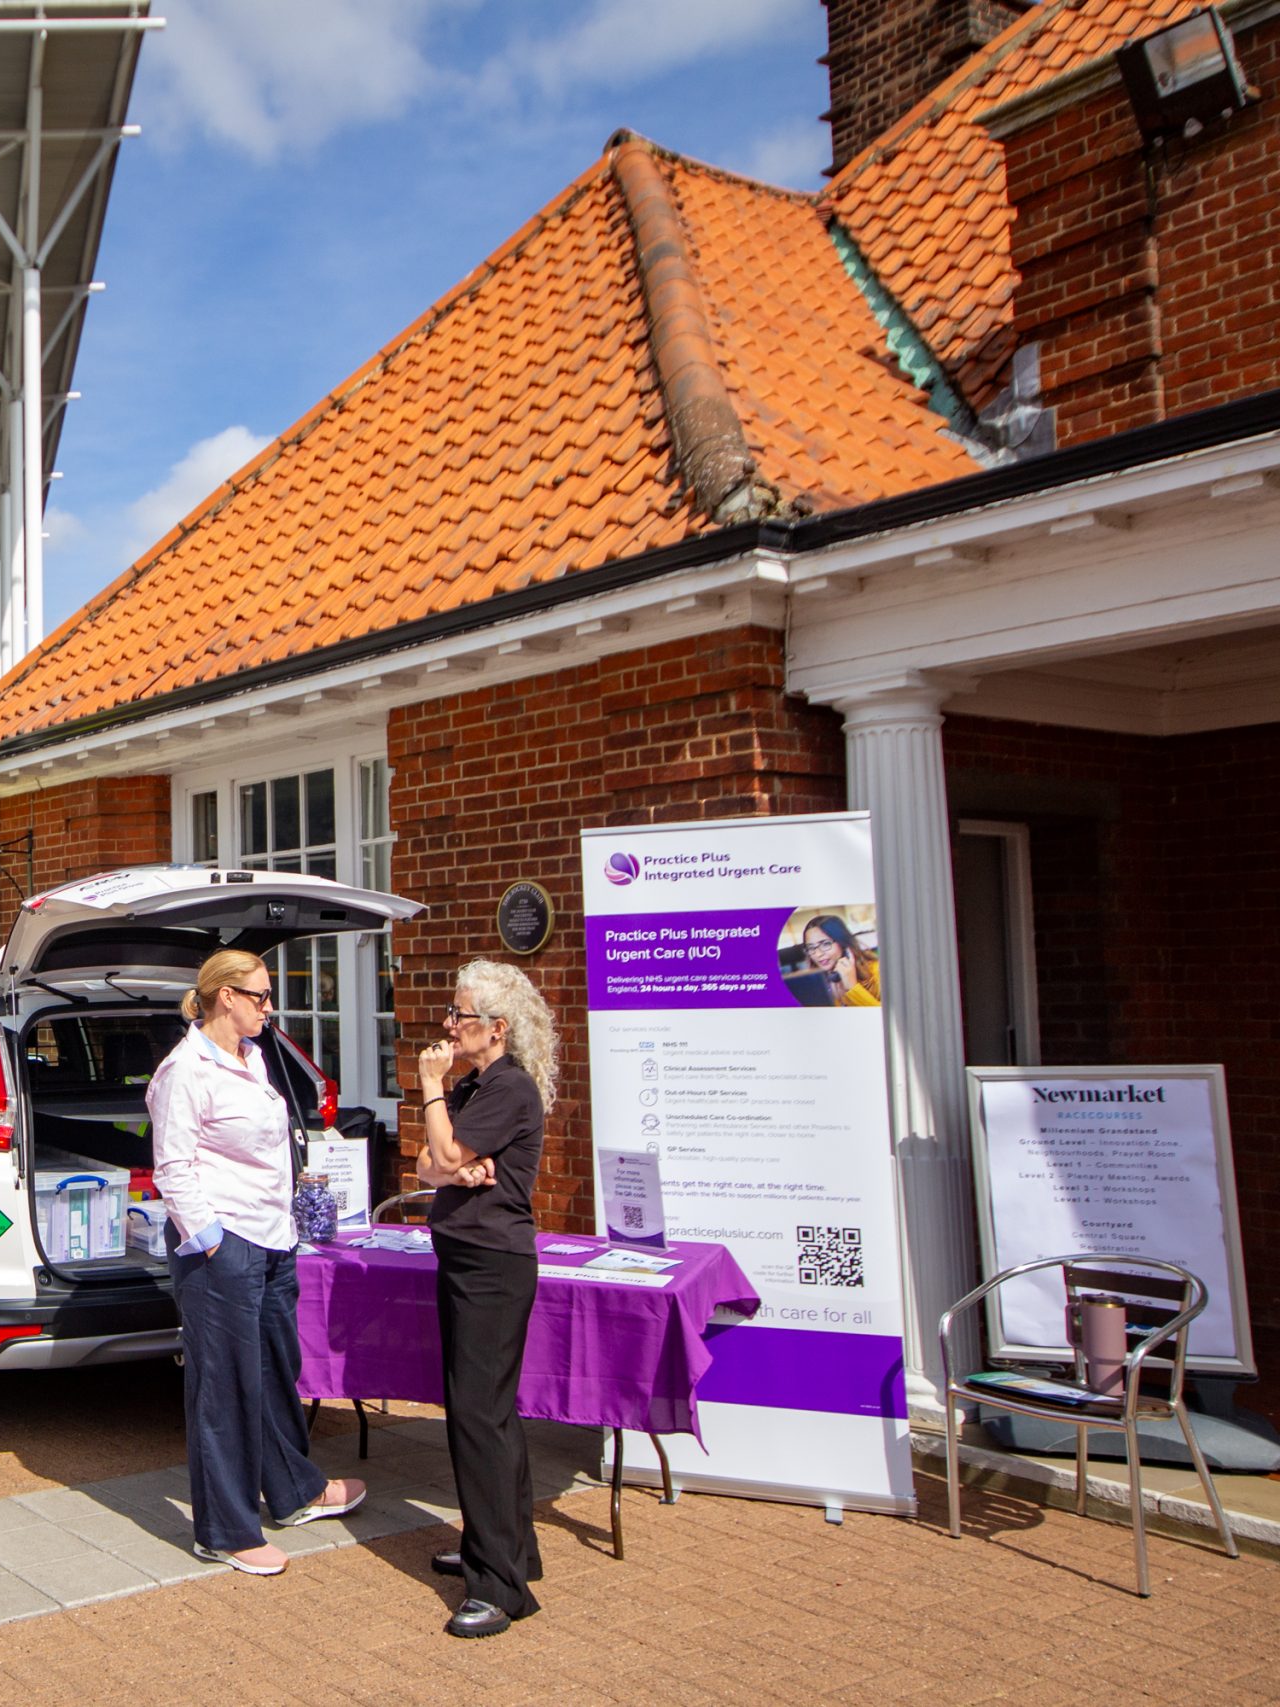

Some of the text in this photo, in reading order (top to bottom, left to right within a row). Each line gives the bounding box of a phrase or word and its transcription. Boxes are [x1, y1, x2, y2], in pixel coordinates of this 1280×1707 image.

[644, 852, 731, 866] Practice Plus
[644, 864, 802, 882] Integrated Urgent Care
[605, 925, 761, 942] Practice Plus Integrated
[606, 945, 721, 963] Urgent Care (IUC)
[607, 975, 644, 985] Delivering
[645, 975, 663, 983] NHS
[652, 984, 675, 992] hours
[719, 983, 738, 992] days
[1032, 1084, 1166, 1103] Newmarket
[1057, 1111, 1143, 1120] RACECOURSES
[1040, 1127, 1158, 1135] Millennium Grandstand
[1059, 1138, 1086, 1146] Level
[1112, 1150, 1145, 1158] Prayer
[1095, 1162, 1158, 1170] Communities
[1067, 1173, 1103, 1181] Plenary
[682, 1180, 696, 1189] get
[698, 1180, 711, 1188] the
[713, 1180, 733, 1190] right
[757, 1182, 766, 1190] at
[767, 1182, 781, 1190] the
[784, 1182, 803, 1192] right
[1103, 1186, 1155, 1194] Workshops
[1104, 1197, 1157, 1206] Workshops
[1081, 1220, 1133, 1229] Courtyard
[665, 1226, 784, 1240] .practiceplusiuc.com
[1072, 1231, 1146, 1241] Central Square
[780, 1307, 872, 1325] care for all
